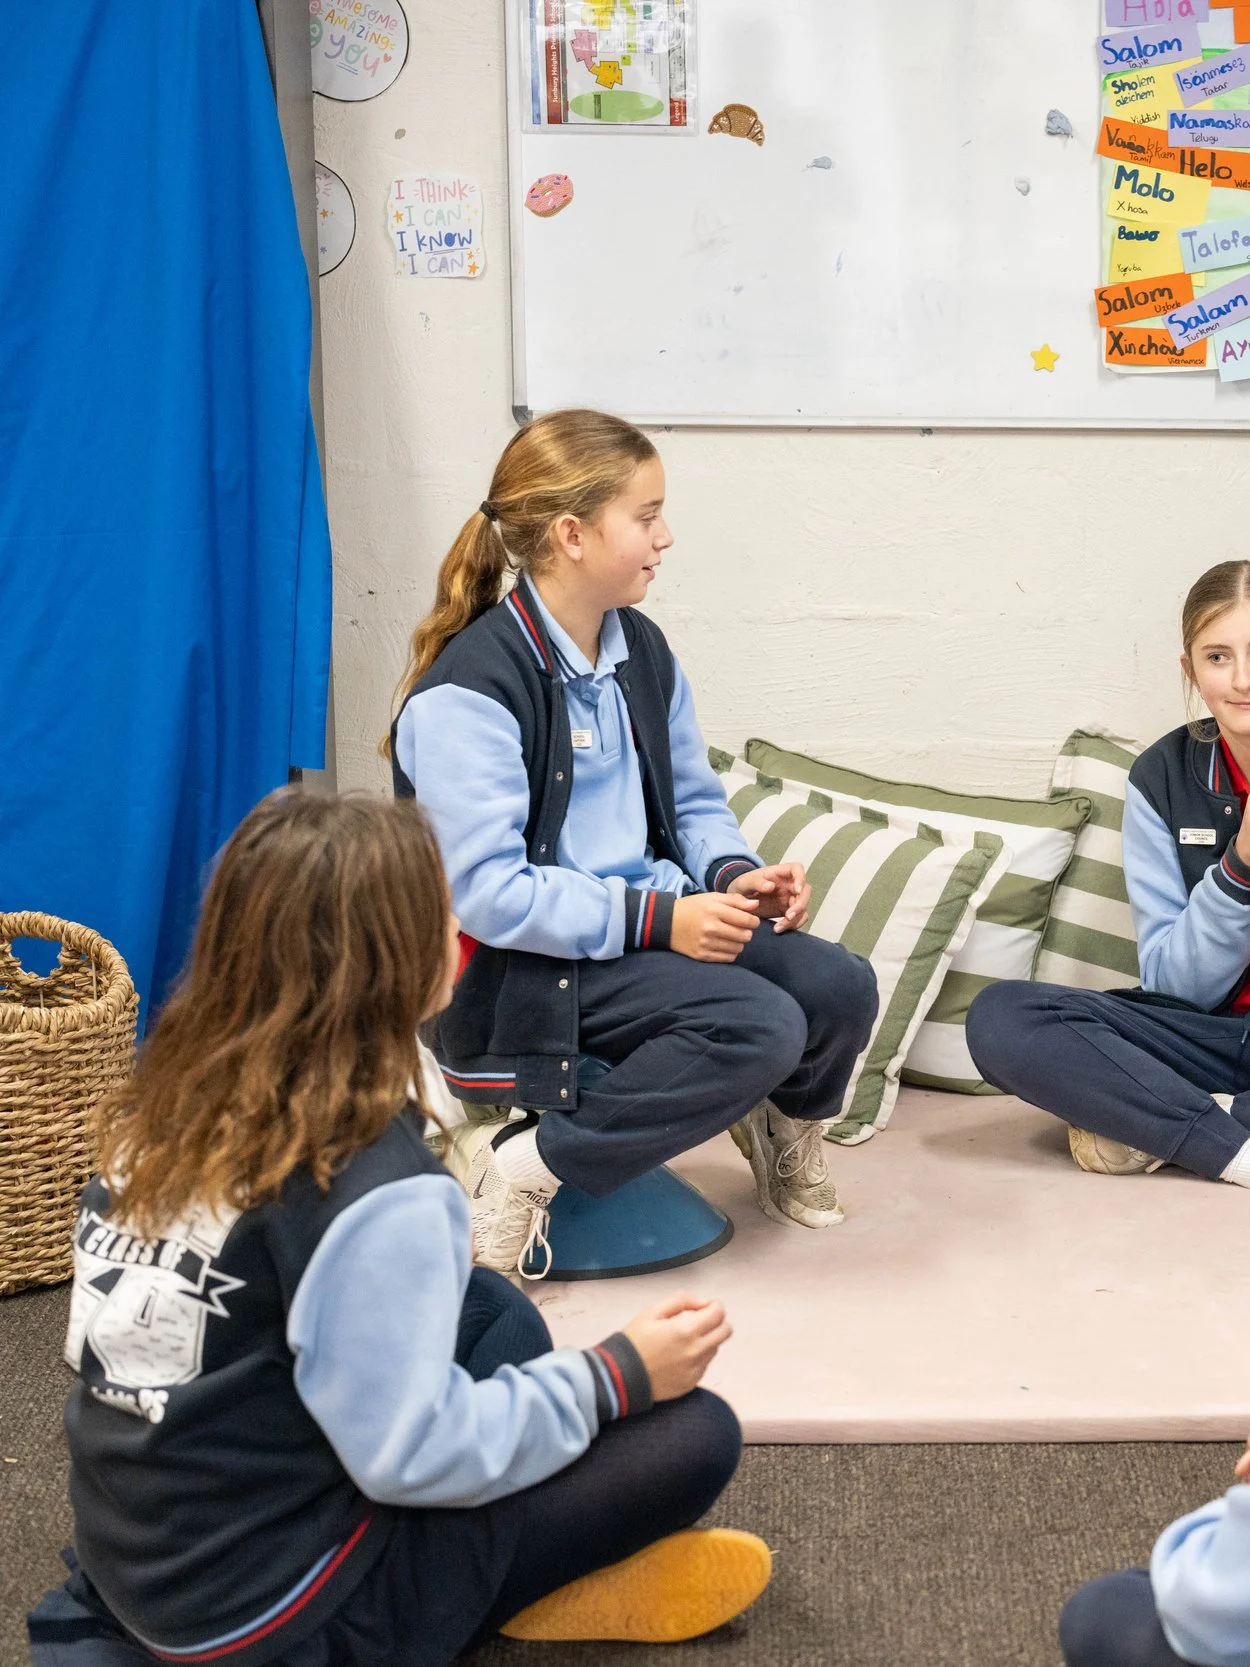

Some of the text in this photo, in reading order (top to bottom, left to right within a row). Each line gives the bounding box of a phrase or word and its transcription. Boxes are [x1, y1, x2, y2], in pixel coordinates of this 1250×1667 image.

[1101, 36, 1183, 65] Salom
[1201, 82, 1229, 96] Tatar
[1179, 149, 1233, 180] Helo
[1114, 164, 1175, 202] Molo
[423, 204, 462, 226] CAN
[1116, 200, 1149, 215] Xhosa
[427, 252, 464, 274] CAN
[1098, 286, 1174, 316] Salom
[1168, 293, 1248, 336] Salam
[84, 1227, 188, 1271] CLASS OF
